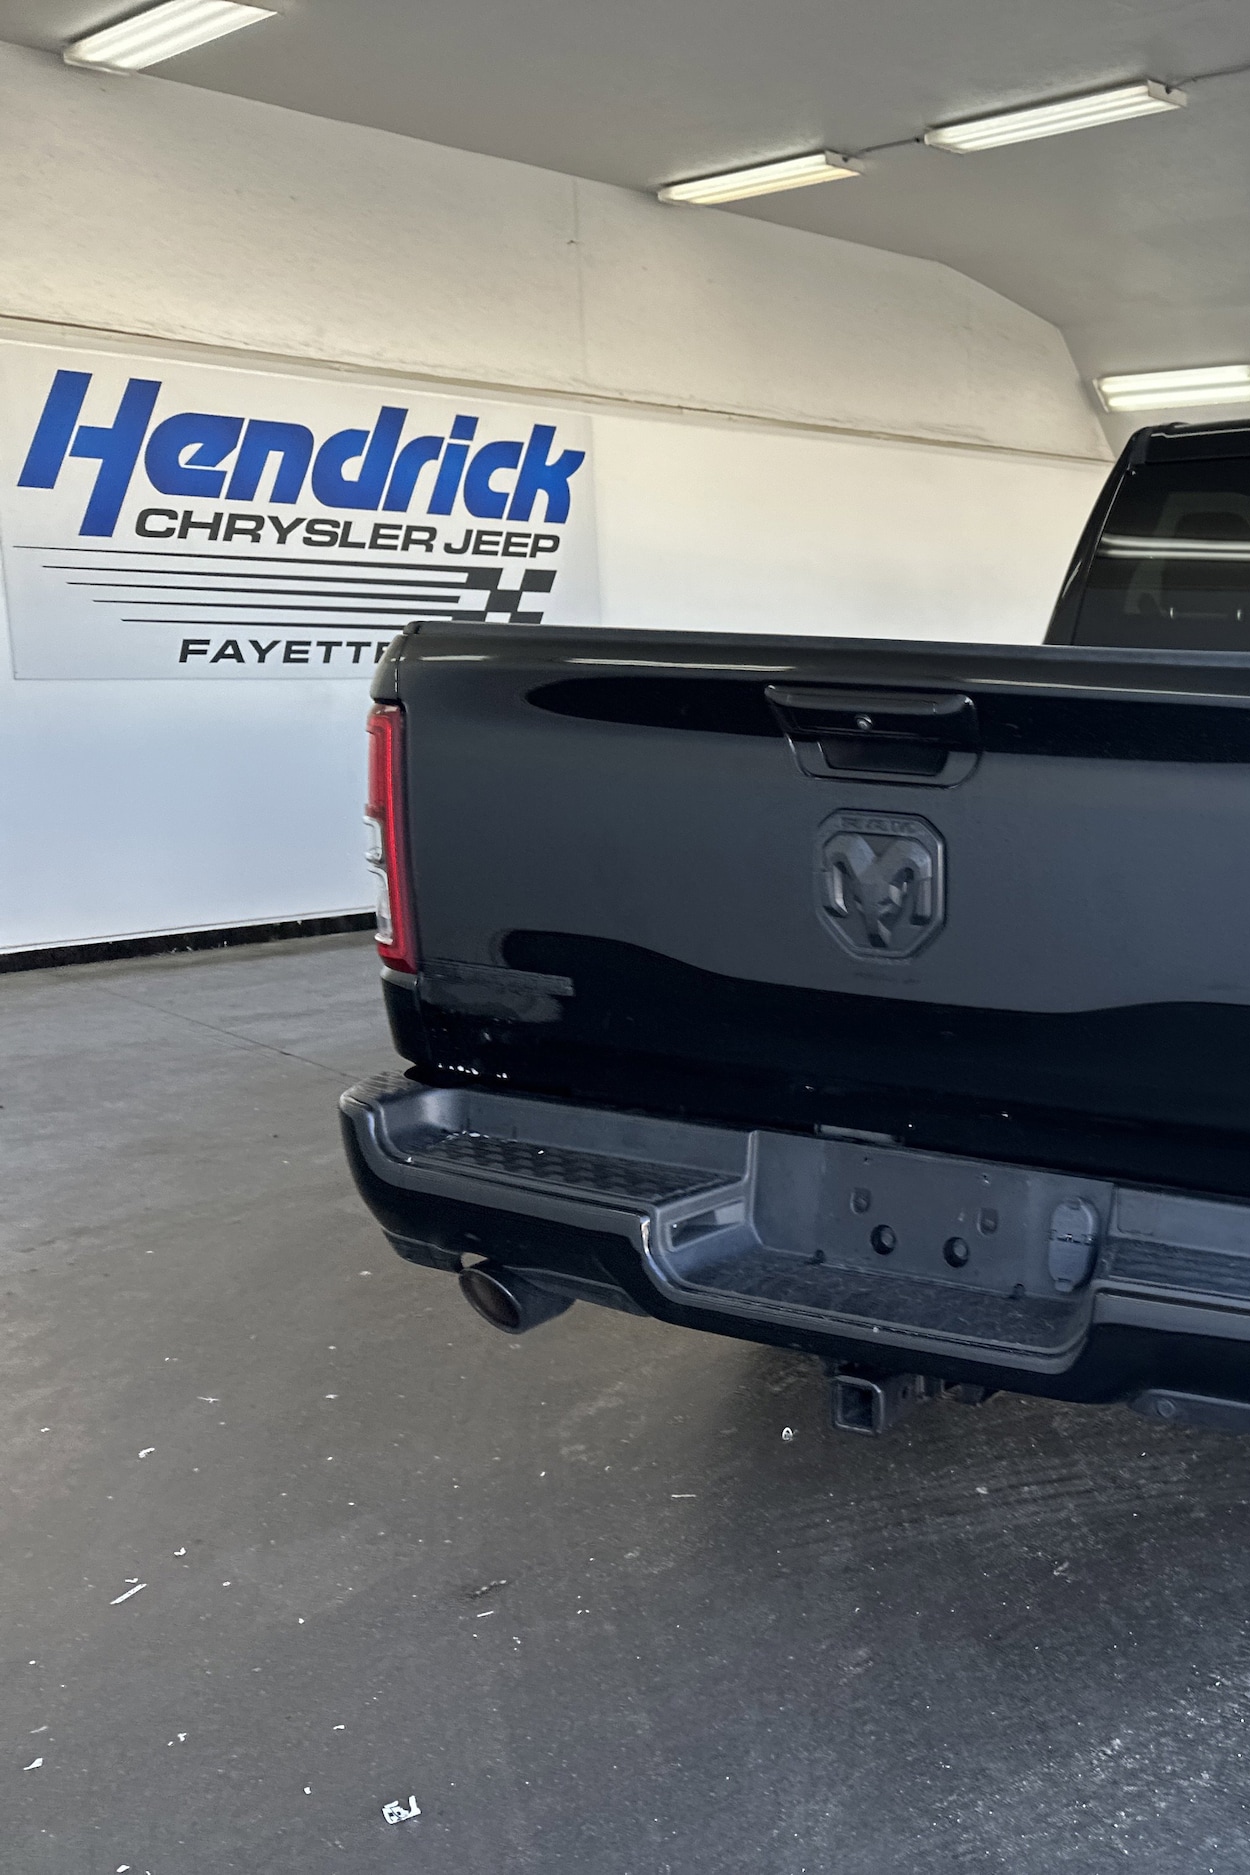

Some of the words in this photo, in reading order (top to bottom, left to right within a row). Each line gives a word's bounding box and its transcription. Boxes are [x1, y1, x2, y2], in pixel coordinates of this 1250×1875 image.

[17, 369, 586, 538] Hendrick
[134, 508, 438, 553] CHRYSLER
[443, 528, 561, 559] JEEP
